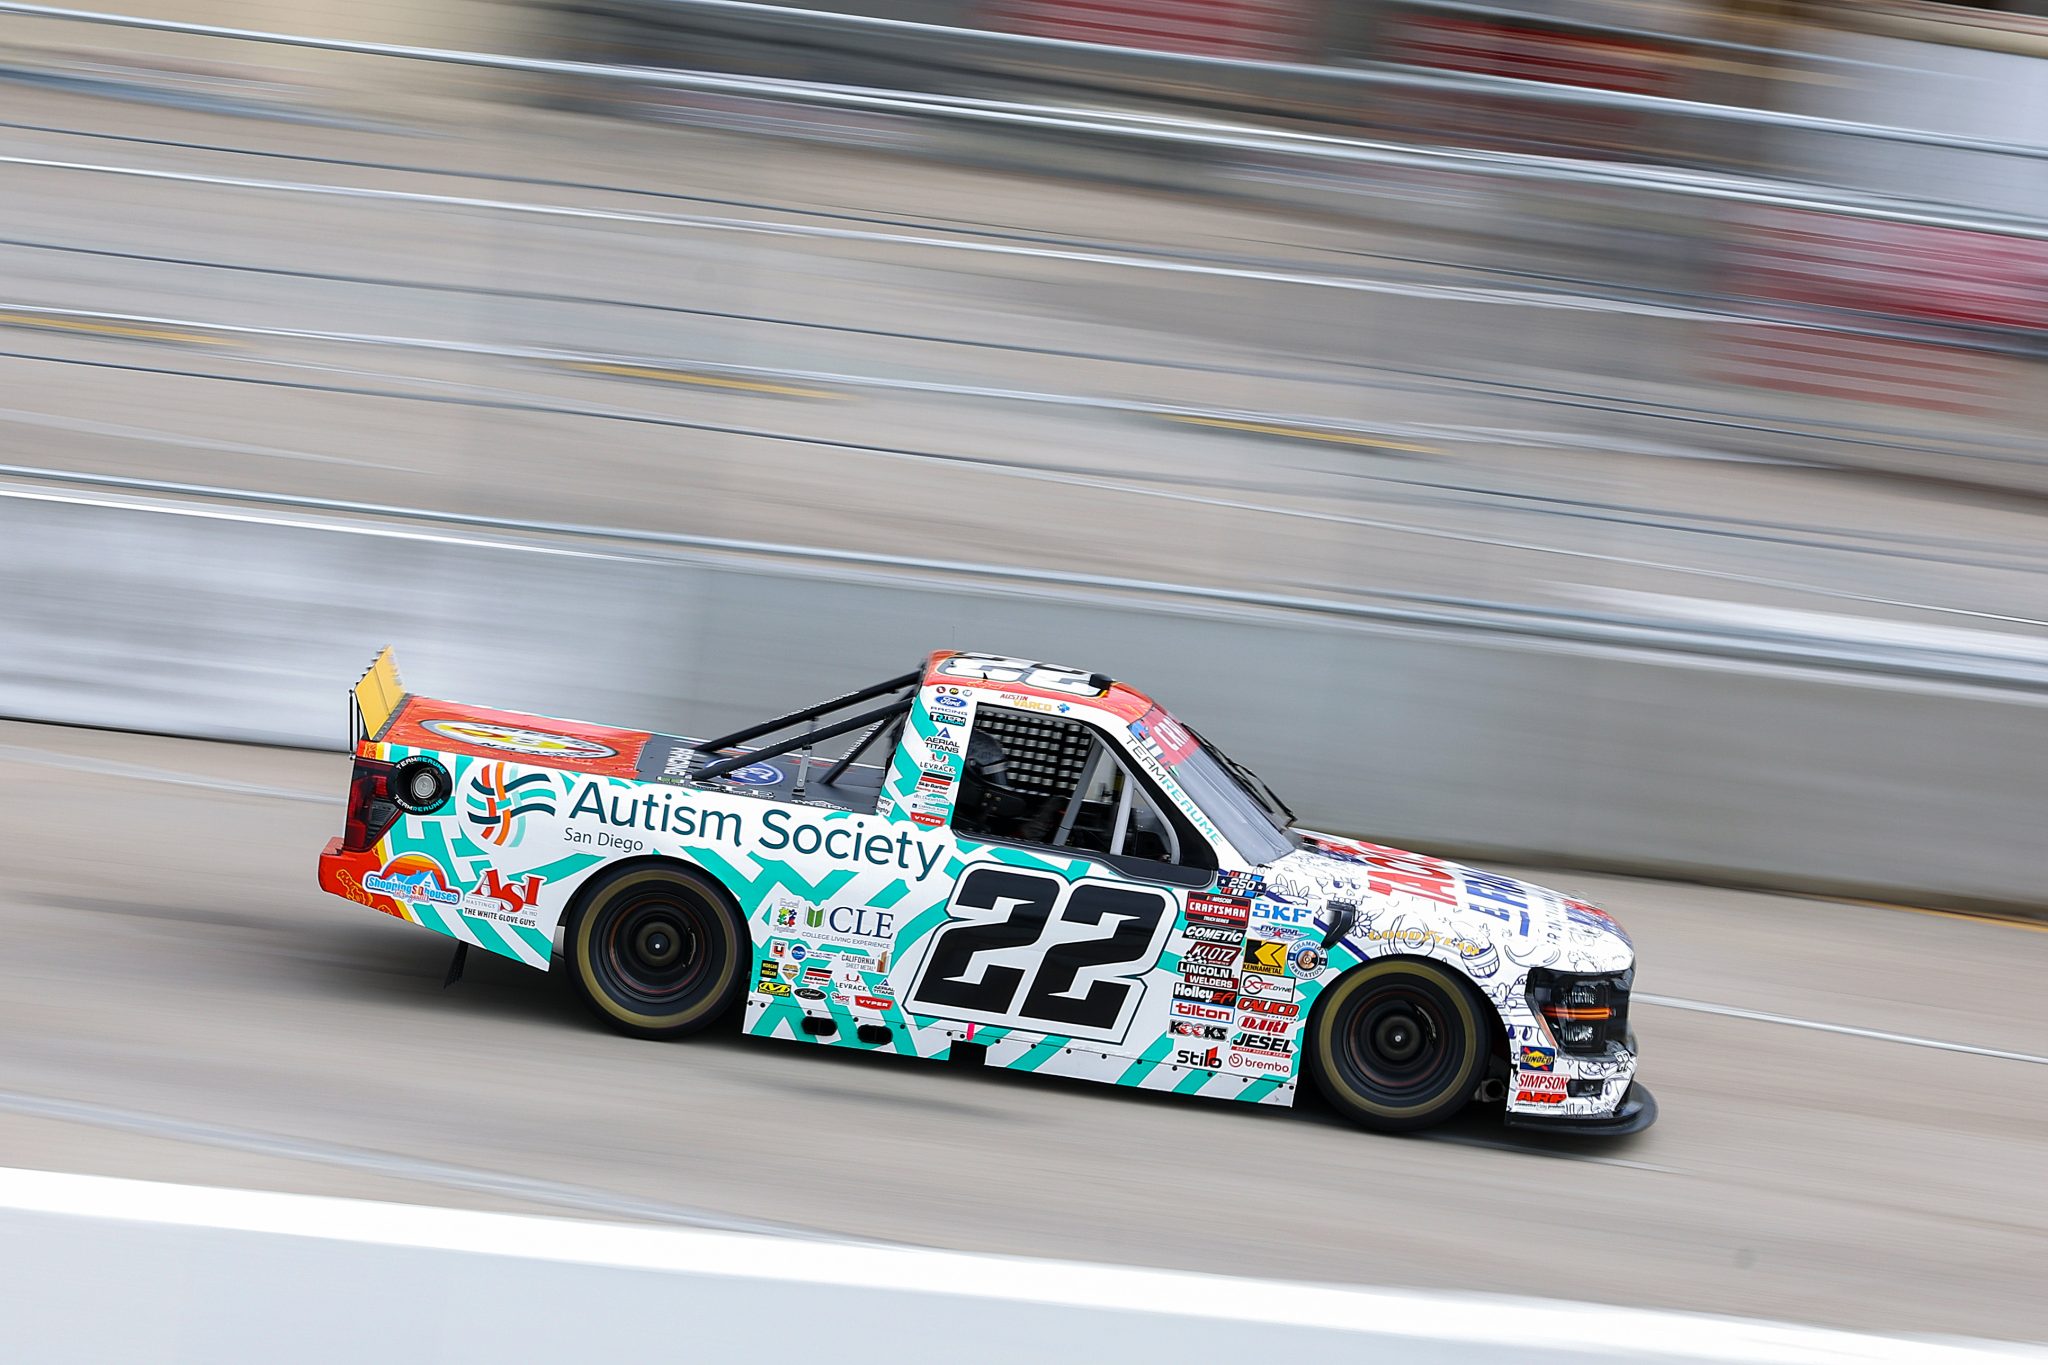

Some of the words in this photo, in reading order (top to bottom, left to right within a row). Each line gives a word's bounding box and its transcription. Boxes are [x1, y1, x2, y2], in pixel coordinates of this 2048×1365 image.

[1000, 693, 1029, 701] AUSTIN
[1013, 700, 1052, 712] VARCO
[925, 743, 960, 754] TITANS
[926, 737, 960, 748] AERIAL
[920, 762, 954, 773] LEVRACK
[914, 815, 942, 824] VYPER
[564, 826, 592, 843] San
[597, 832, 644, 853] Diego
[569, 781, 742, 847] Autism
[758, 809, 945, 882] Society
[471, 868, 545, 913] ASI
[1228, 877, 1257, 891] 250
[1211, 896, 1233, 904] NASCAR
[464, 907, 476, 916] THE
[477, 910, 498, 920] WHITE
[498, 914, 518, 924] GLOVE
[519, 918, 536, 927] GUYS
[1189, 902, 1246, 918] CRAFTSMAN
[1252, 903, 1312, 923] SKF
[829, 906, 895, 940] CLE
[802, 931, 830, 940] COLLEGE
[831, 934, 852, 944] LIVING
[852, 937, 891, 950] EXPERIENCE
[1185, 925, 1243, 943] COMETIC
[911, 867, 1167, 1030] 22
[1191, 944, 1237, 962] KLOTZ
[1293, 941, 1325, 955] CHAMPION
[841, 954, 876, 965] CALIFORNIA
[1180, 963, 1230, 978] LINCOLN
[1243, 964, 1282, 975] KENNAMETAL
[1290, 961, 1322, 978] IRRIGATION
[835, 982, 867, 992] LEVRACK
[1189, 975, 1233, 989] WELDERS
[1175, 983, 1214, 1003] Holley
[859, 999, 889, 1008] VYPER
[1175, 1002, 1230, 1021] tilton
[1237, 997, 1299, 1017] CALICO
[1233, 1033, 1293, 1053] JESEL
[1245, 1057, 1290, 1073] brembo
[1520, 1054, 1553, 1064] SUNOCO
[1518, 1073, 1569, 1090] SIMPSON
